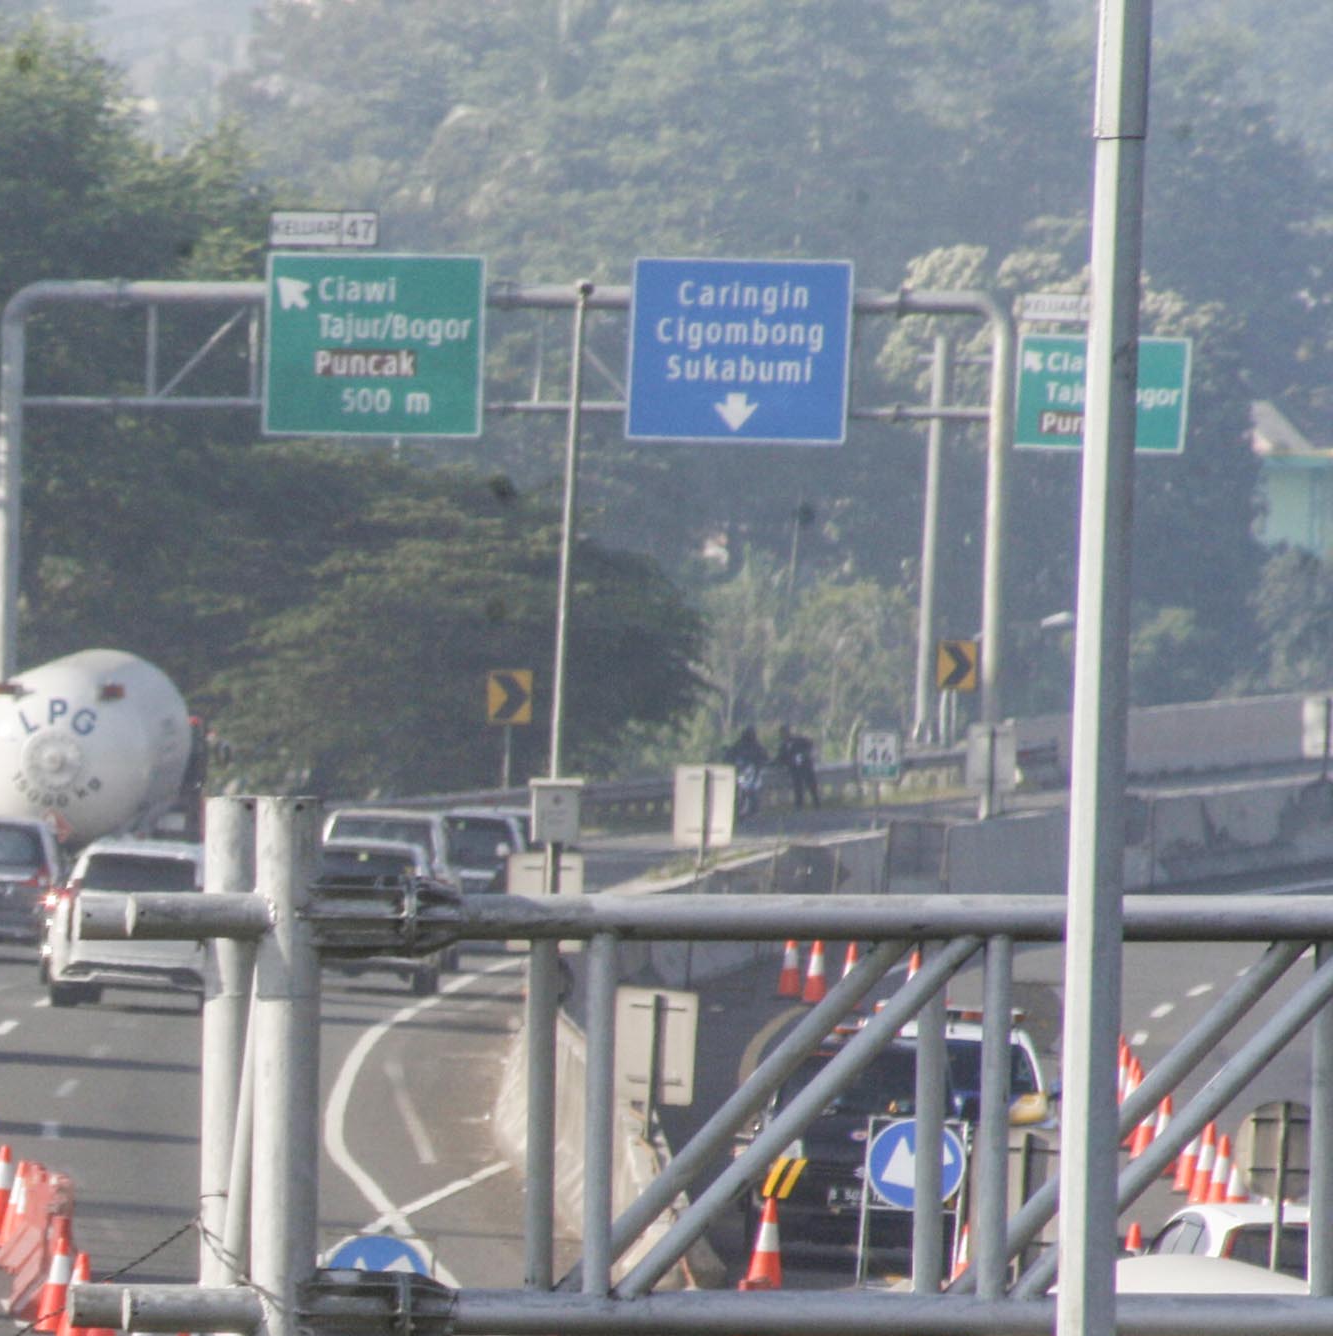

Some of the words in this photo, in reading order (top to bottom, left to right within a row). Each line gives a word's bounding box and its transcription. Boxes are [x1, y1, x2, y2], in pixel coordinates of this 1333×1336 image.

[345, 215, 374, 240] 47
[318, 275, 397, 303] Ciawi
[678, 280, 809, 313] Caringin
[318, 313, 472, 346] Tajur/Bogor
[657, 317, 824, 352] Cigombong
[315, 350, 415, 376] Puncak
[666, 353, 813, 385] Sukabumi
[1047, 352, 1085, 372] Cia
[341, 387, 391, 414] 500
[405, 390, 431, 414] m
[17, 698, 97, 736] LPG
